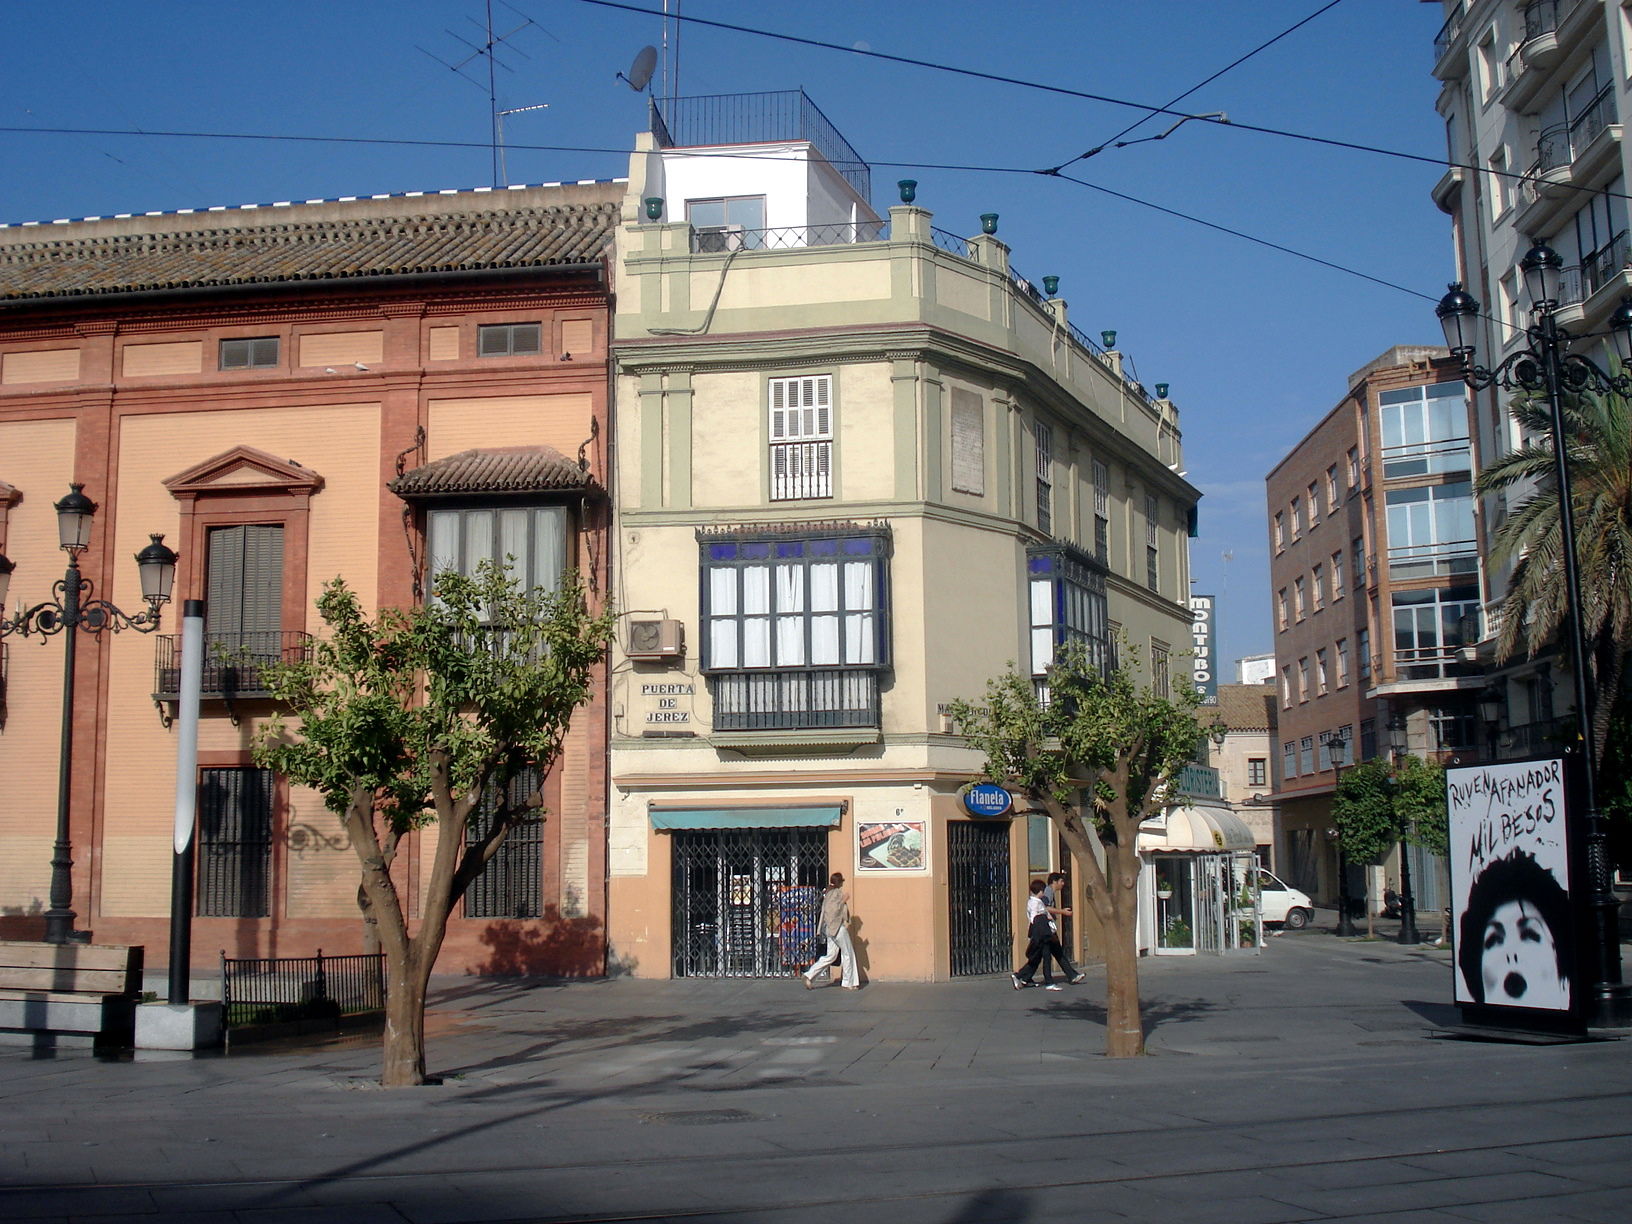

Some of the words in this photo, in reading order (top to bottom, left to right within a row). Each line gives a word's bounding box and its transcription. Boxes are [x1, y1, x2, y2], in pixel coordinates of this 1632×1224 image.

[642, 685, 693, 693] PUERTA
[659, 699, 675, 707] DE
[647, 713, 688, 721] JEREZ
[1180, 766, 1219, 795] LORISTERIA
[970, 789, 1004, 805] Flanela
[1449, 769, 1491, 811] RUVEN
[1487, 761, 1560, 818] AFANADOR
[1501, 788, 1555, 845] BESOS
